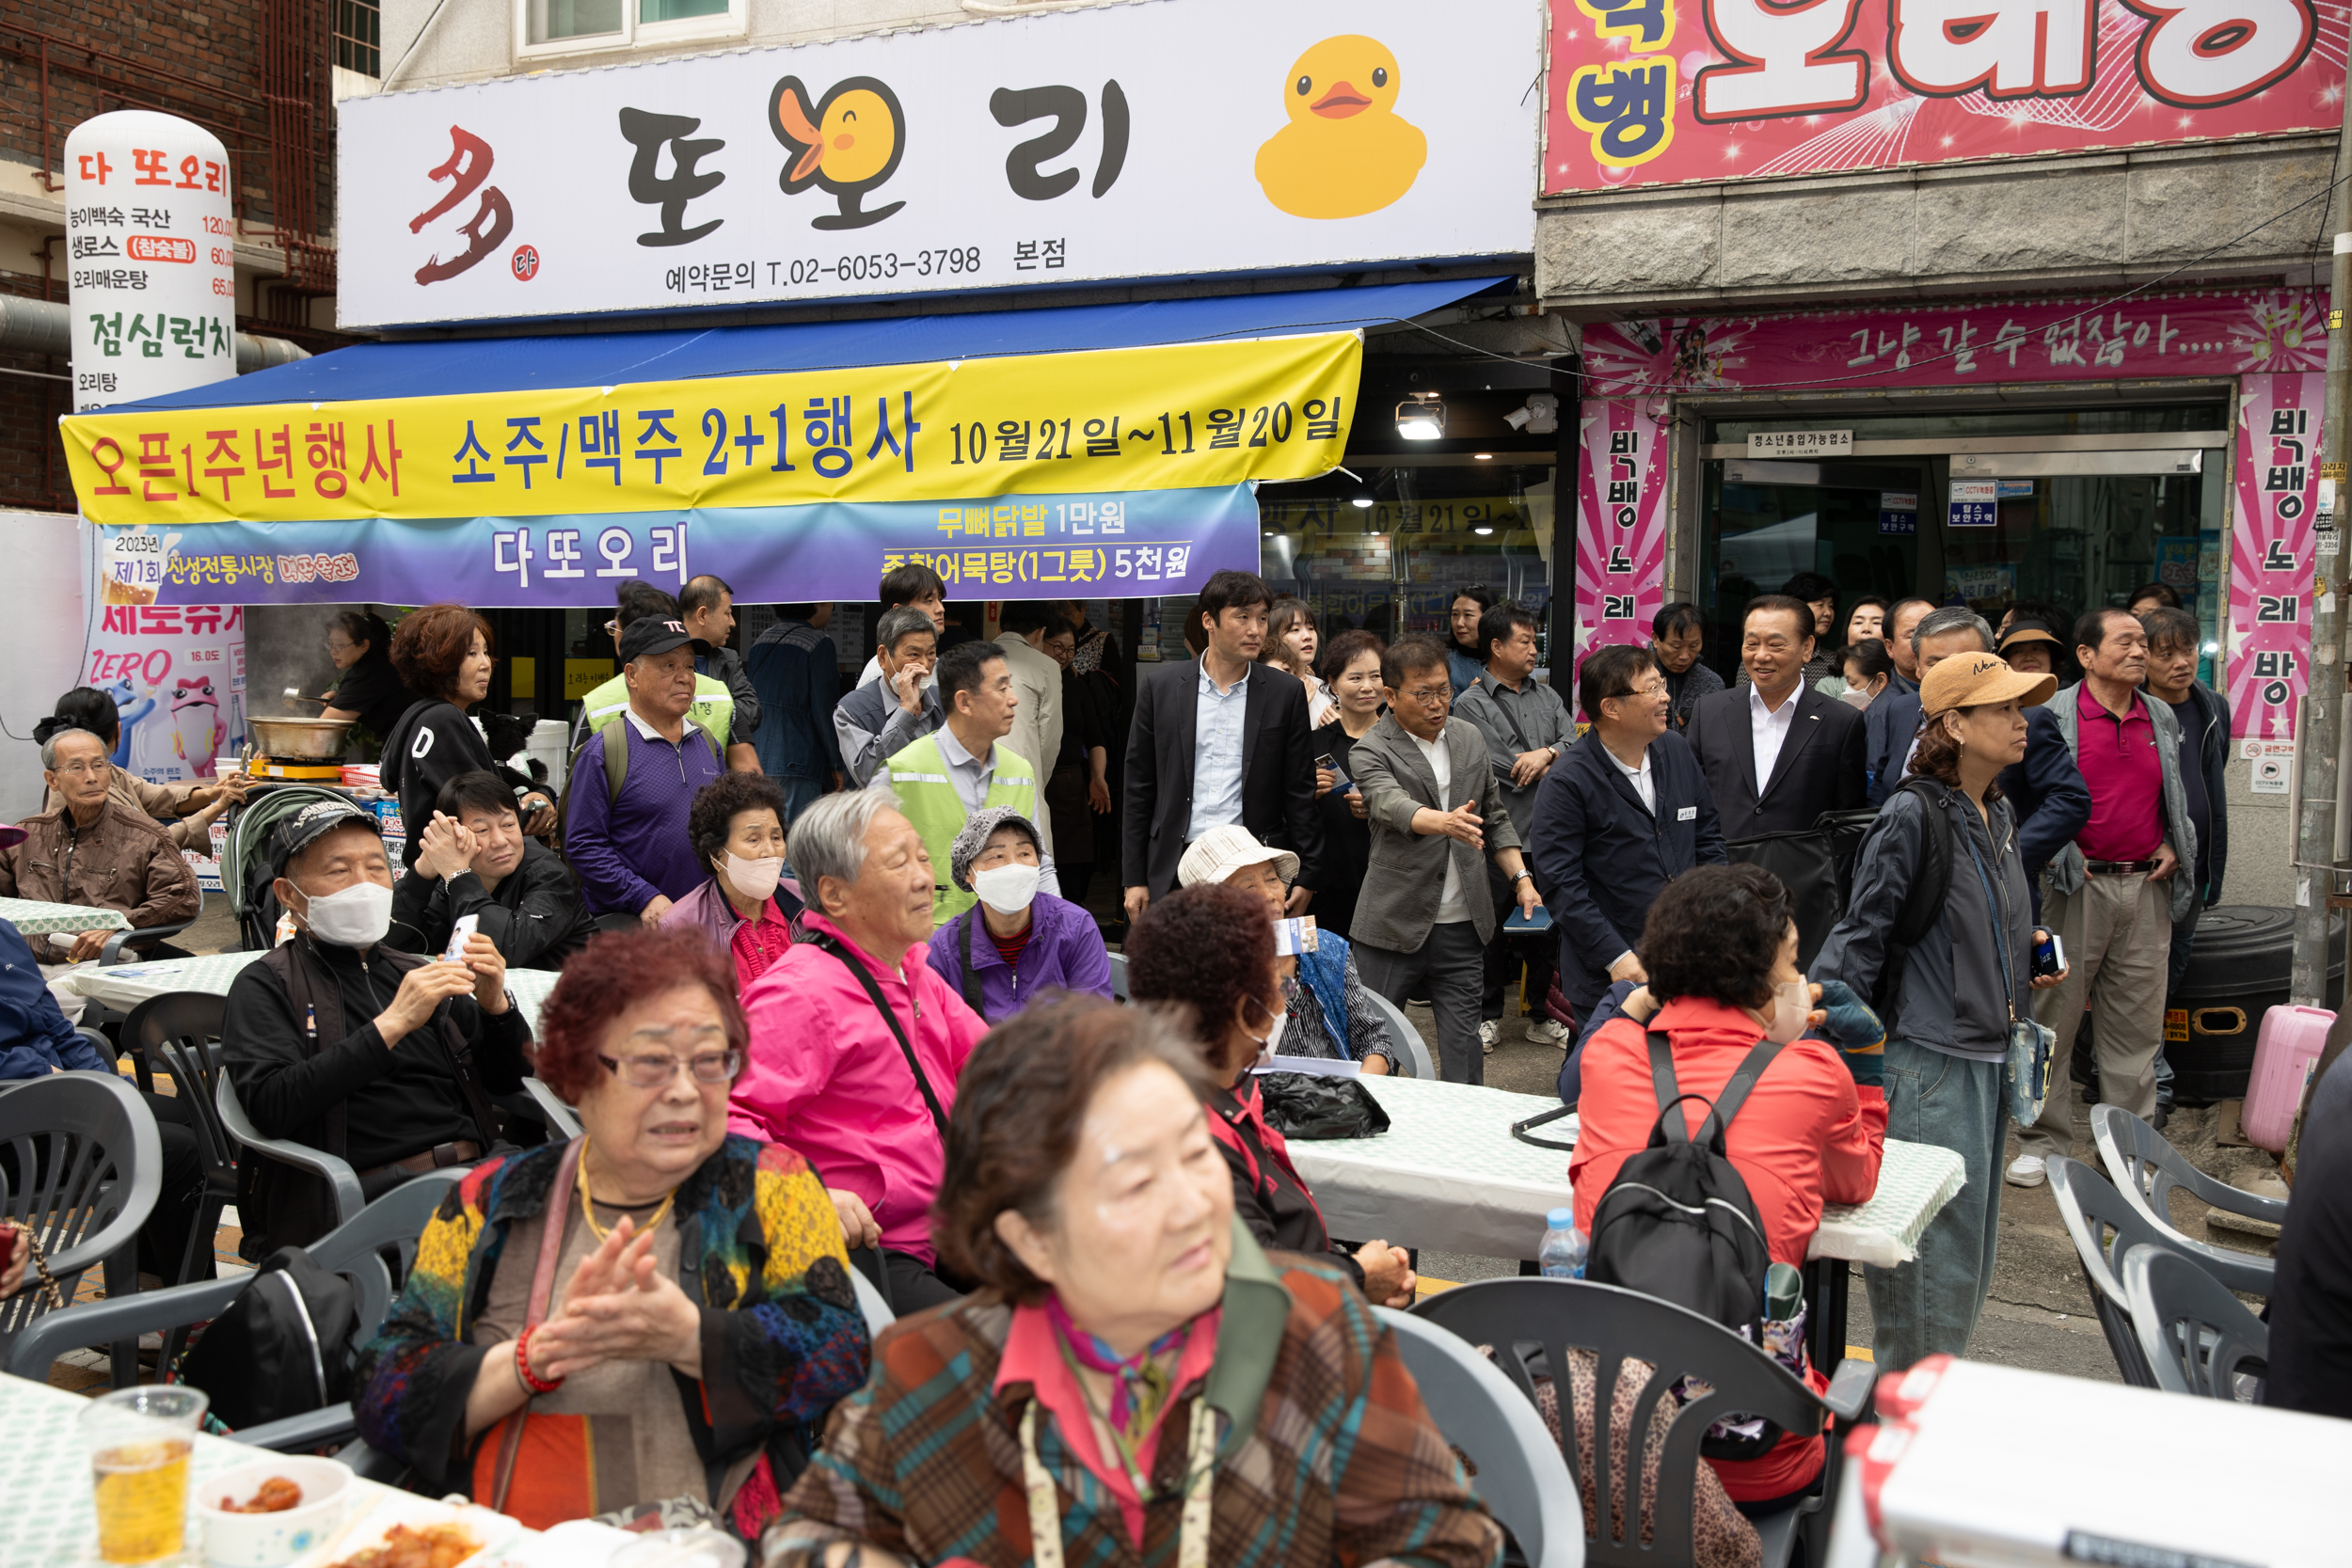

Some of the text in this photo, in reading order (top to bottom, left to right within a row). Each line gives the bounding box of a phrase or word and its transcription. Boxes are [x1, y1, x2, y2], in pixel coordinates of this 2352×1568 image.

[78, 149, 227, 197] 다 또오리
[131, 207, 170, 230] 국산
[72, 235, 120, 261] 생로스
[515, 248, 537, 277] 다
[73, 268, 149, 291] 오리매운탕
[665, 238, 1067, 294] 예약문의 T.02-6053-3798 본점
[89, 311, 231, 359] 점심런치
[1847, 321, 1922, 372] 그냥
[1994, 318, 2026, 368] 수
[79, 372, 118, 393] 오리탕
[91, 419, 403, 502] 오픈1주년행사
[453, 408, 682, 490] 소주/맥주
[701, 390, 921, 479] 2+1행사
[937, 500, 1126, 540] 무뼈닭발 1만원
[1951, 514, 1993, 523] 보안구역
[115, 535, 159, 553] 2023년
[493, 521, 688, 588] 다또오리
[114, 559, 161, 585] 제1회
[167, 553, 275, 585] 신성전통시장
[1115, 545, 1192, 579] 5천원
[89, 649, 172, 685] ZERO
[191, 650, 220, 662] 16.0도
[412, 726, 435, 759] D
